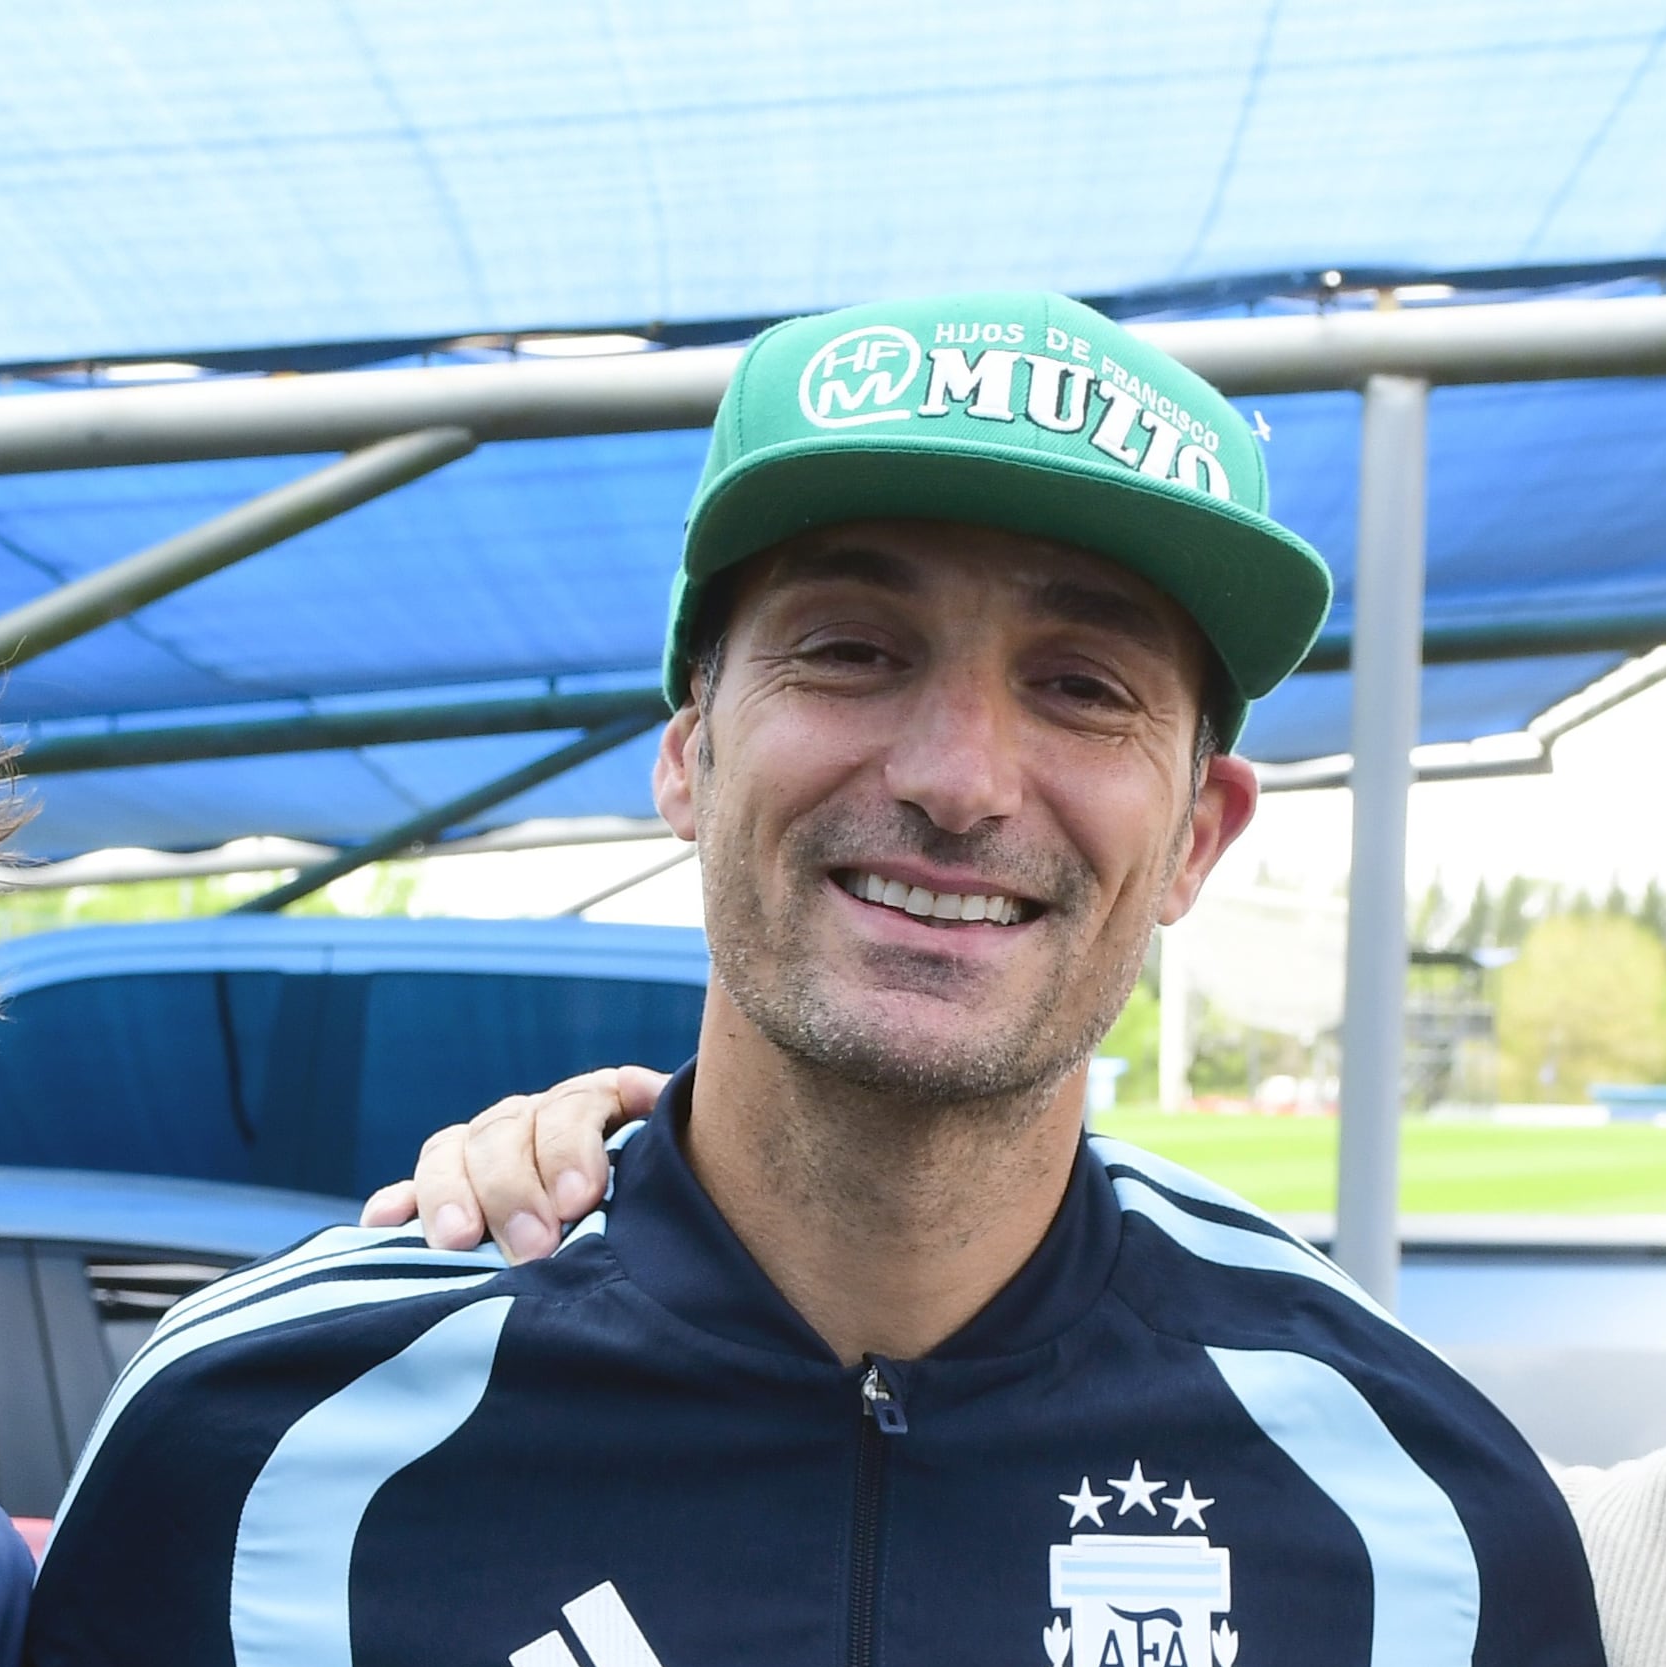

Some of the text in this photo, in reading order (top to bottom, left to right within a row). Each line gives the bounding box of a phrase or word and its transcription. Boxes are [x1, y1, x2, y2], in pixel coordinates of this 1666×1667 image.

[934, 322, 1219, 452] HIJOS DE FRANCISCO
